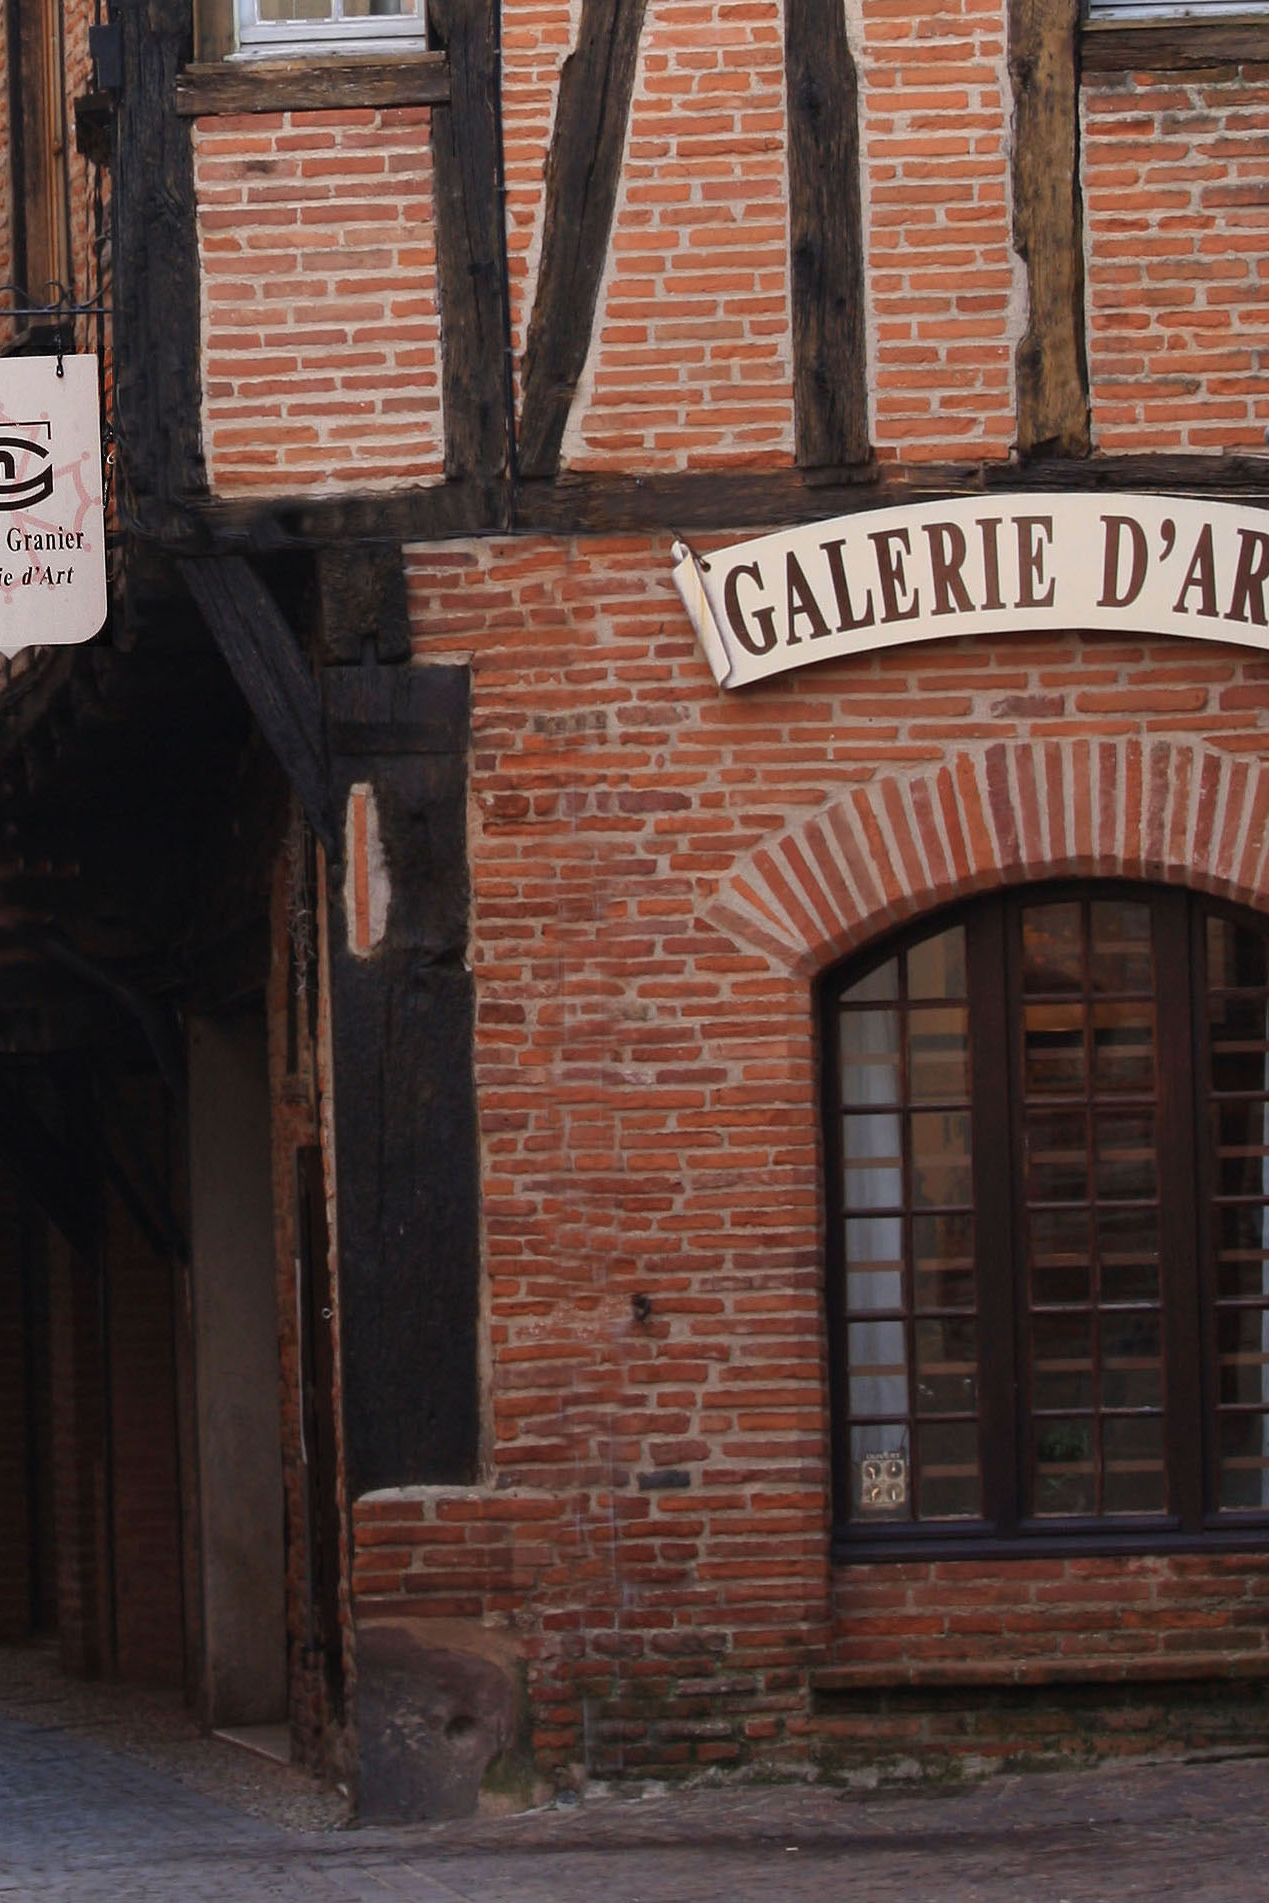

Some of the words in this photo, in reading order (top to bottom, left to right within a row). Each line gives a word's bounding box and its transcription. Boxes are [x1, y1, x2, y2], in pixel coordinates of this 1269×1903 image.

[6, 526, 85, 552] Granier
[21, 565, 75, 586] d'Art
[723, 515, 1057, 656] GALERIE
[1096, 515, 1269, 627] D'AR
